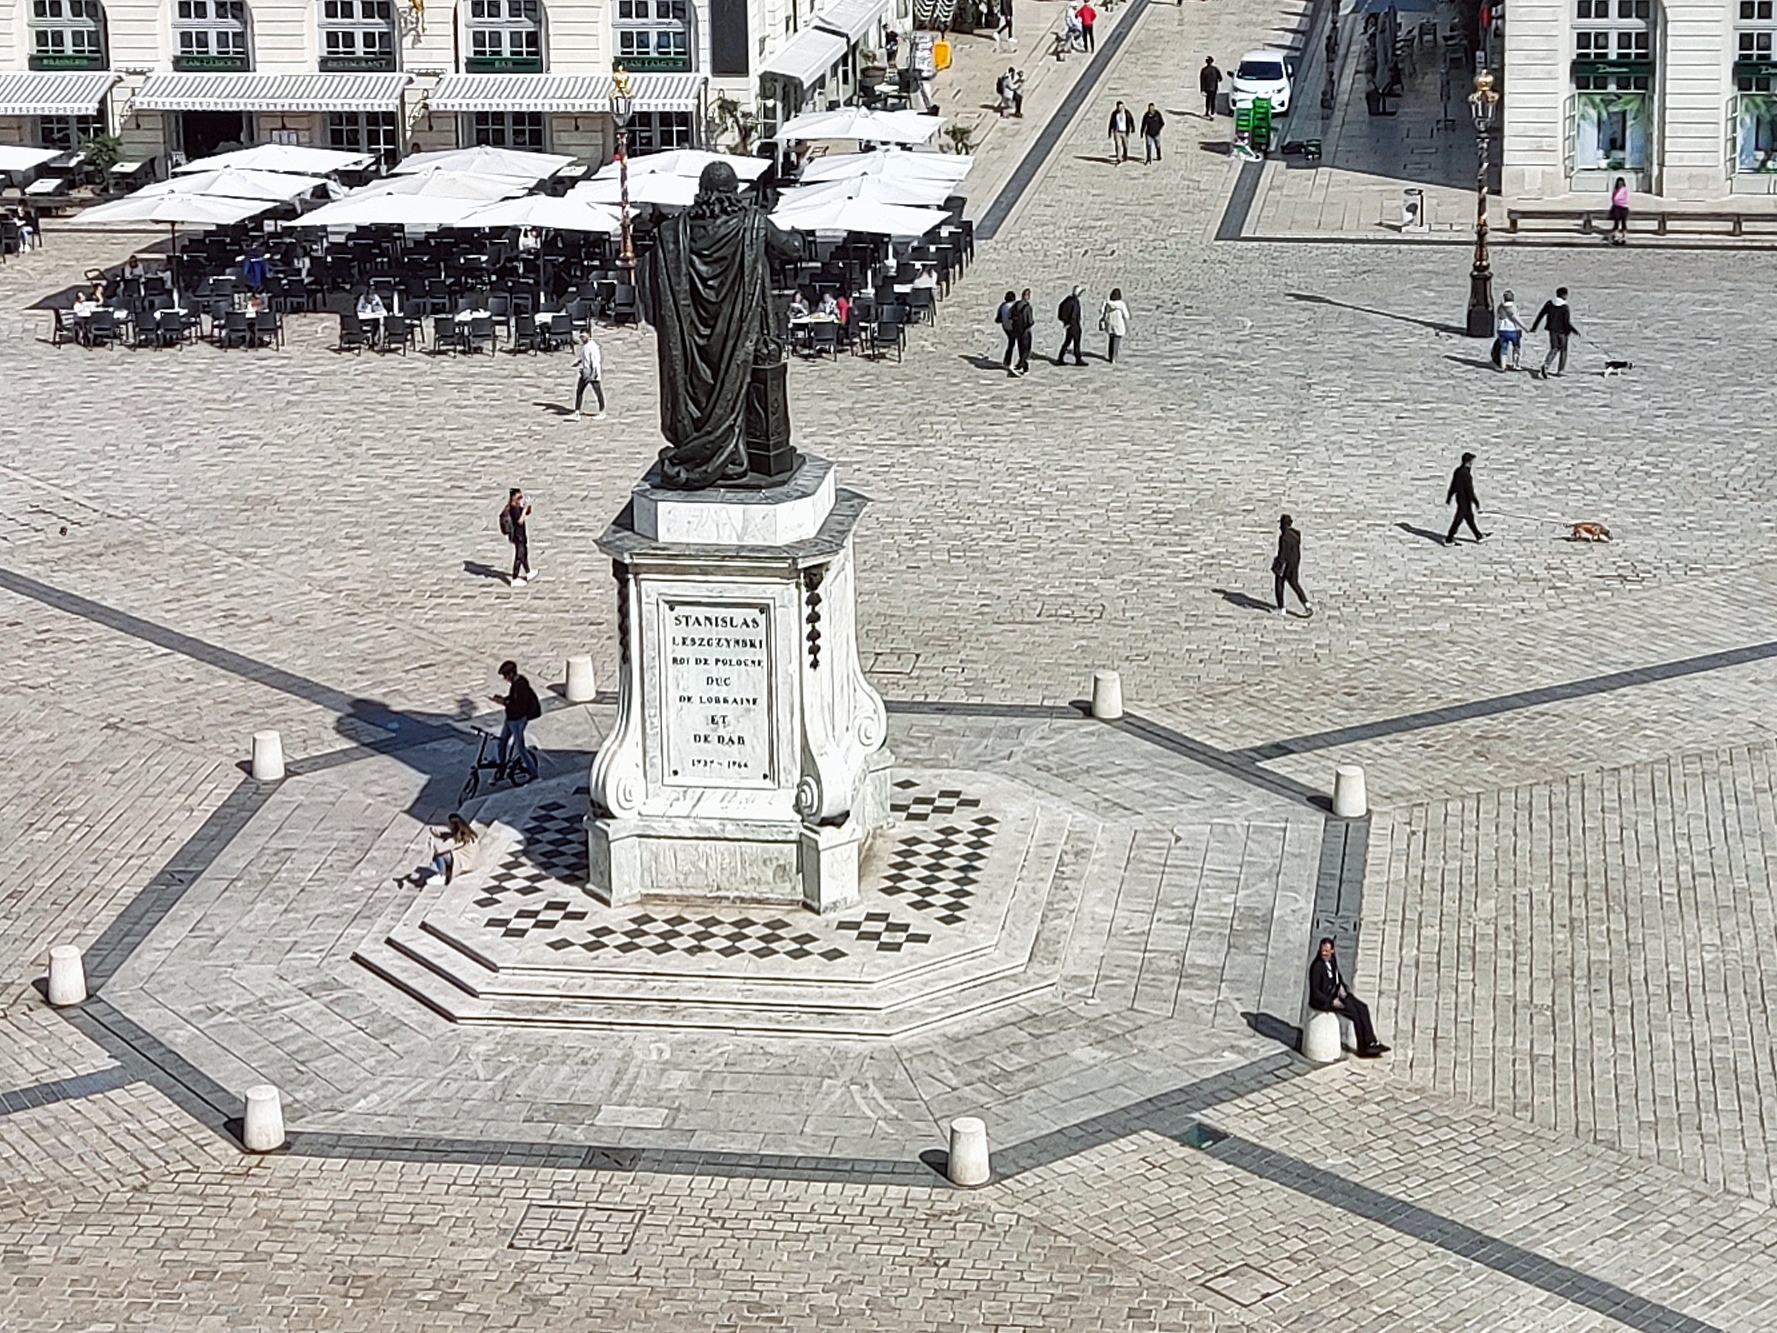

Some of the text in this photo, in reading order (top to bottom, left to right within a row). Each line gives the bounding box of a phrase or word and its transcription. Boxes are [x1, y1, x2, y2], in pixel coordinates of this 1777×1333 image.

[674, 614, 760, 629] STANISLAS
[672, 656, 763, 667] ROI DE POLOGNE
[706, 676, 731, 687] DUC
[678, 694, 759, 706] DE LORRAINE
[710, 714, 729, 725] ET
[693, 733, 746, 746] DE BAR
